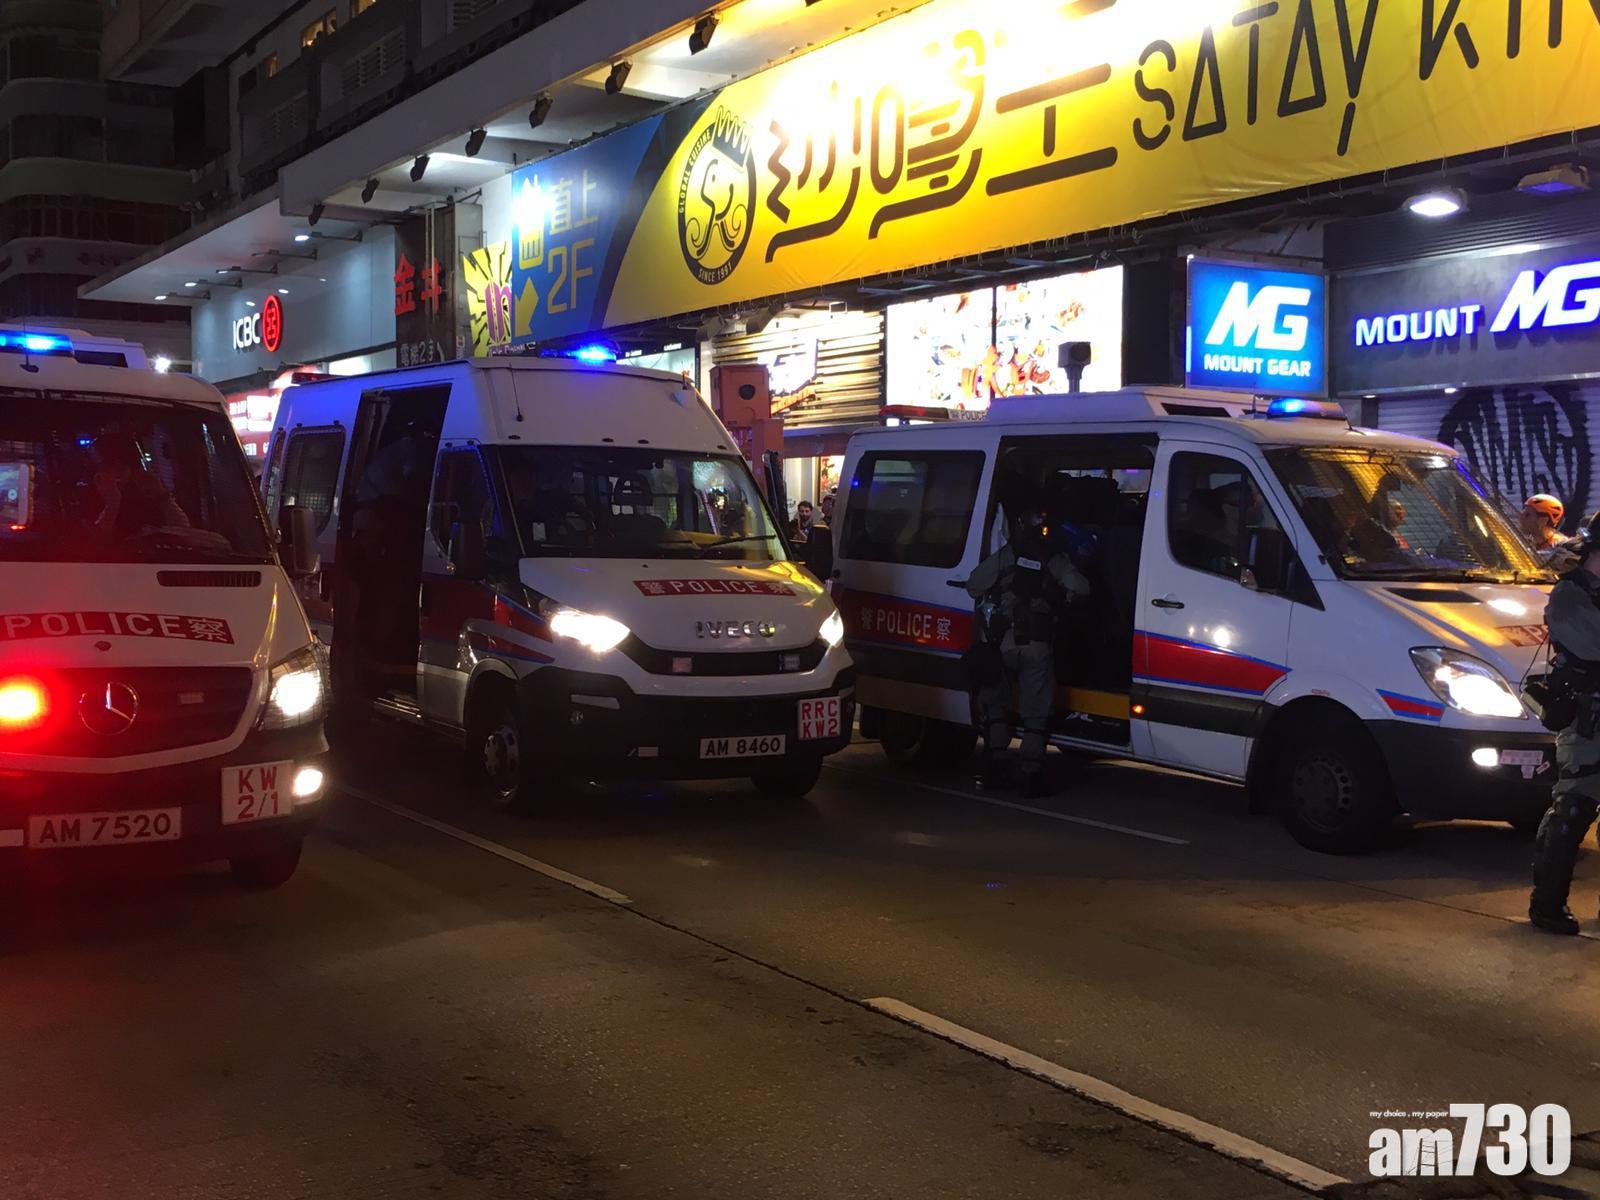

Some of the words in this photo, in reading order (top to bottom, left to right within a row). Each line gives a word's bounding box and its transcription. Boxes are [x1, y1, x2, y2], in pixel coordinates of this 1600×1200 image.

[1134, 0, 1379, 156] SATAY
[679, 170, 690, 213] GLOBAL
[688, 129, 711, 166] CUISINE
[548, 238, 594, 314] 2F
[699, 269, 716, 283] SINCE
[1205, 282, 1311, 350] MG
[1355, 305, 1480, 346] MOUNT
[233, 313, 260, 349] ICBC
[1204, 354, 1263, 374] MOUNT
[1267, 357, 1311, 376] GEAR
[672, 581, 763, 593] POLICE
[4, 613, 187, 639] POLICE
[187, 617, 228, 642] 察
[695, 621, 776, 639] IVECO
[877, 609, 933, 638] POLICE
[937, 617, 951, 641] 察
[801, 699, 838, 721] RRC
[803, 717, 838, 738] KW2
[705, 741, 728, 756] AM
[736, 737, 780, 753] 8460
[237, 791, 279, 819] 2/1
[39, 819, 80, 844] AM
[91, 812, 171, 841] 7520
